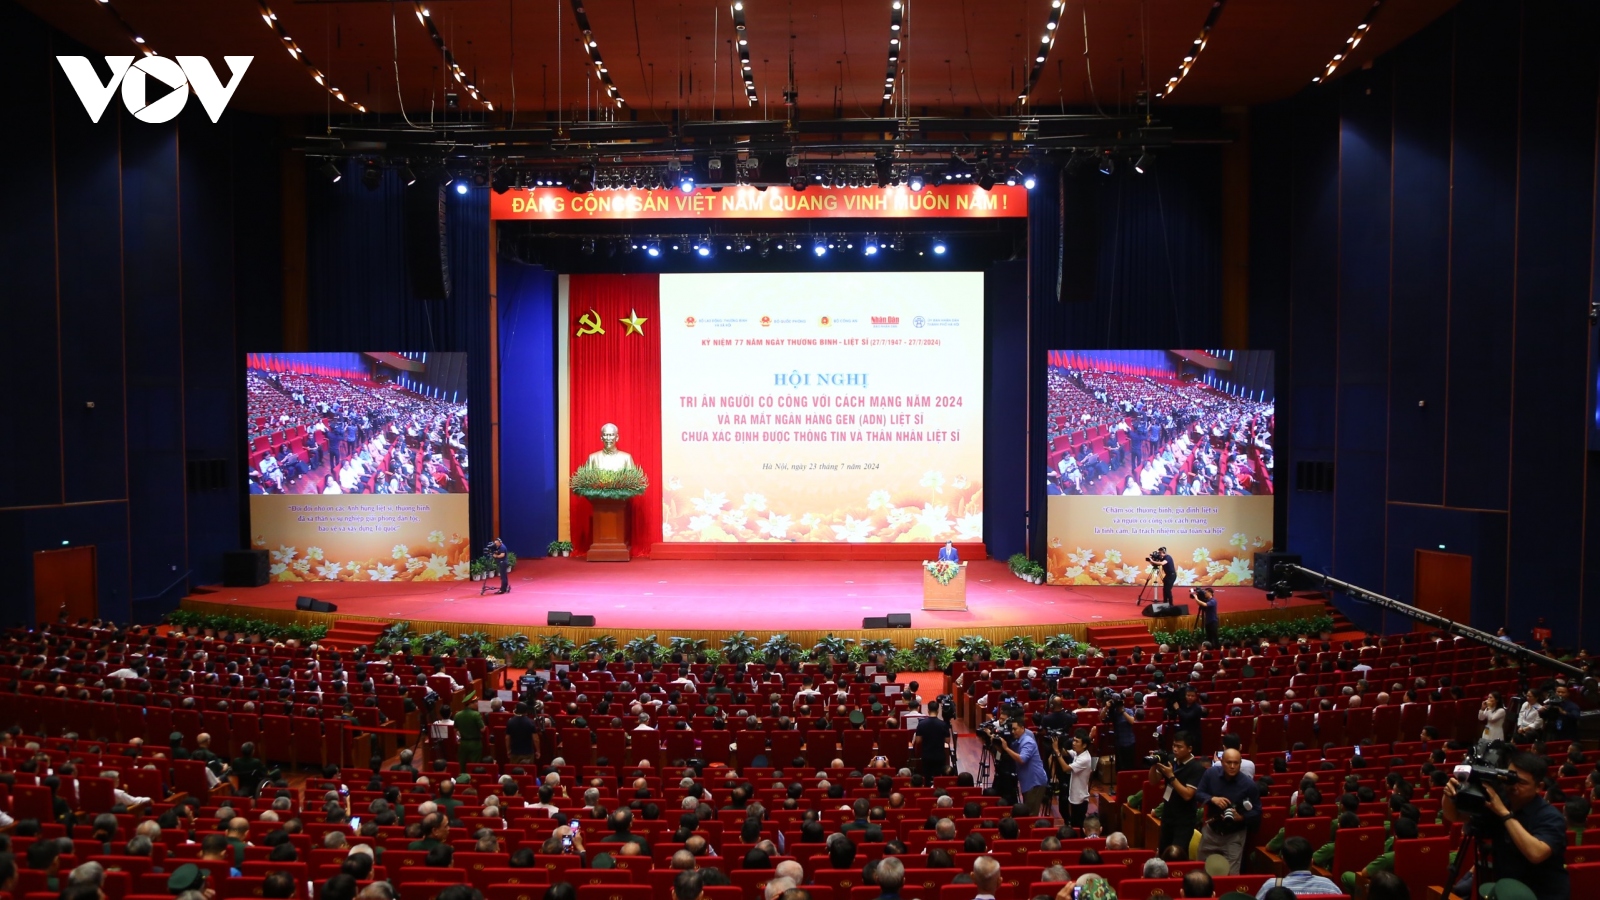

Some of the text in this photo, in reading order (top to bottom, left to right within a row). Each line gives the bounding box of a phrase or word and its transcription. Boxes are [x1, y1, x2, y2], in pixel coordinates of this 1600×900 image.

[512, 192, 565, 213] ĐẢNG
[631, 191, 669, 211] SẢN
[675, 192, 716, 215] VIỆT
[722, 195, 763, 211] NAM
[769, 195, 838, 212] QUANG
[843, 194, 887, 210] VINH
[894, 190, 950, 210] MUÔN
[702, 338, 711, 346] KỶ
[713, 338, 732, 347] NIỆM
[746, 338, 764, 346] NĂM
[766, 338, 785, 346] NGÀY
[787, 338, 817, 346] THƯƠNG
[844, 338, 859, 347] LIỆT
[860, 338, 868, 346] SĨ
[774, 370, 869, 388] HỘI NGHỊ
[680, 394, 963, 410] TRI ÂN NGƯỜI CÓ CÔNG VỚI CÁCH MẠNG NĂM 2024
[718, 412, 731, 425] VÀ
[734, 414, 747, 425] RA
[775, 412, 802, 425] NGÂN
[805, 412, 832, 425] HÀNG
[836, 414, 855, 425] GEN
[859, 414, 887, 426] (ADN)
[890, 412, 910, 427] LIỆT
[914, 412, 924, 425] SĨ
[682, 428, 960, 444] CHƯA XÁC ĐỊNH ĐƯỢC THÔNG TIN VÀ THÂN NHÂN LIỆT SĨ
[762, 462, 773, 470] Hà
[775, 462, 788, 471] Nội,
[791, 462, 806, 472] ngày
[819, 462, 838, 472] tháng
